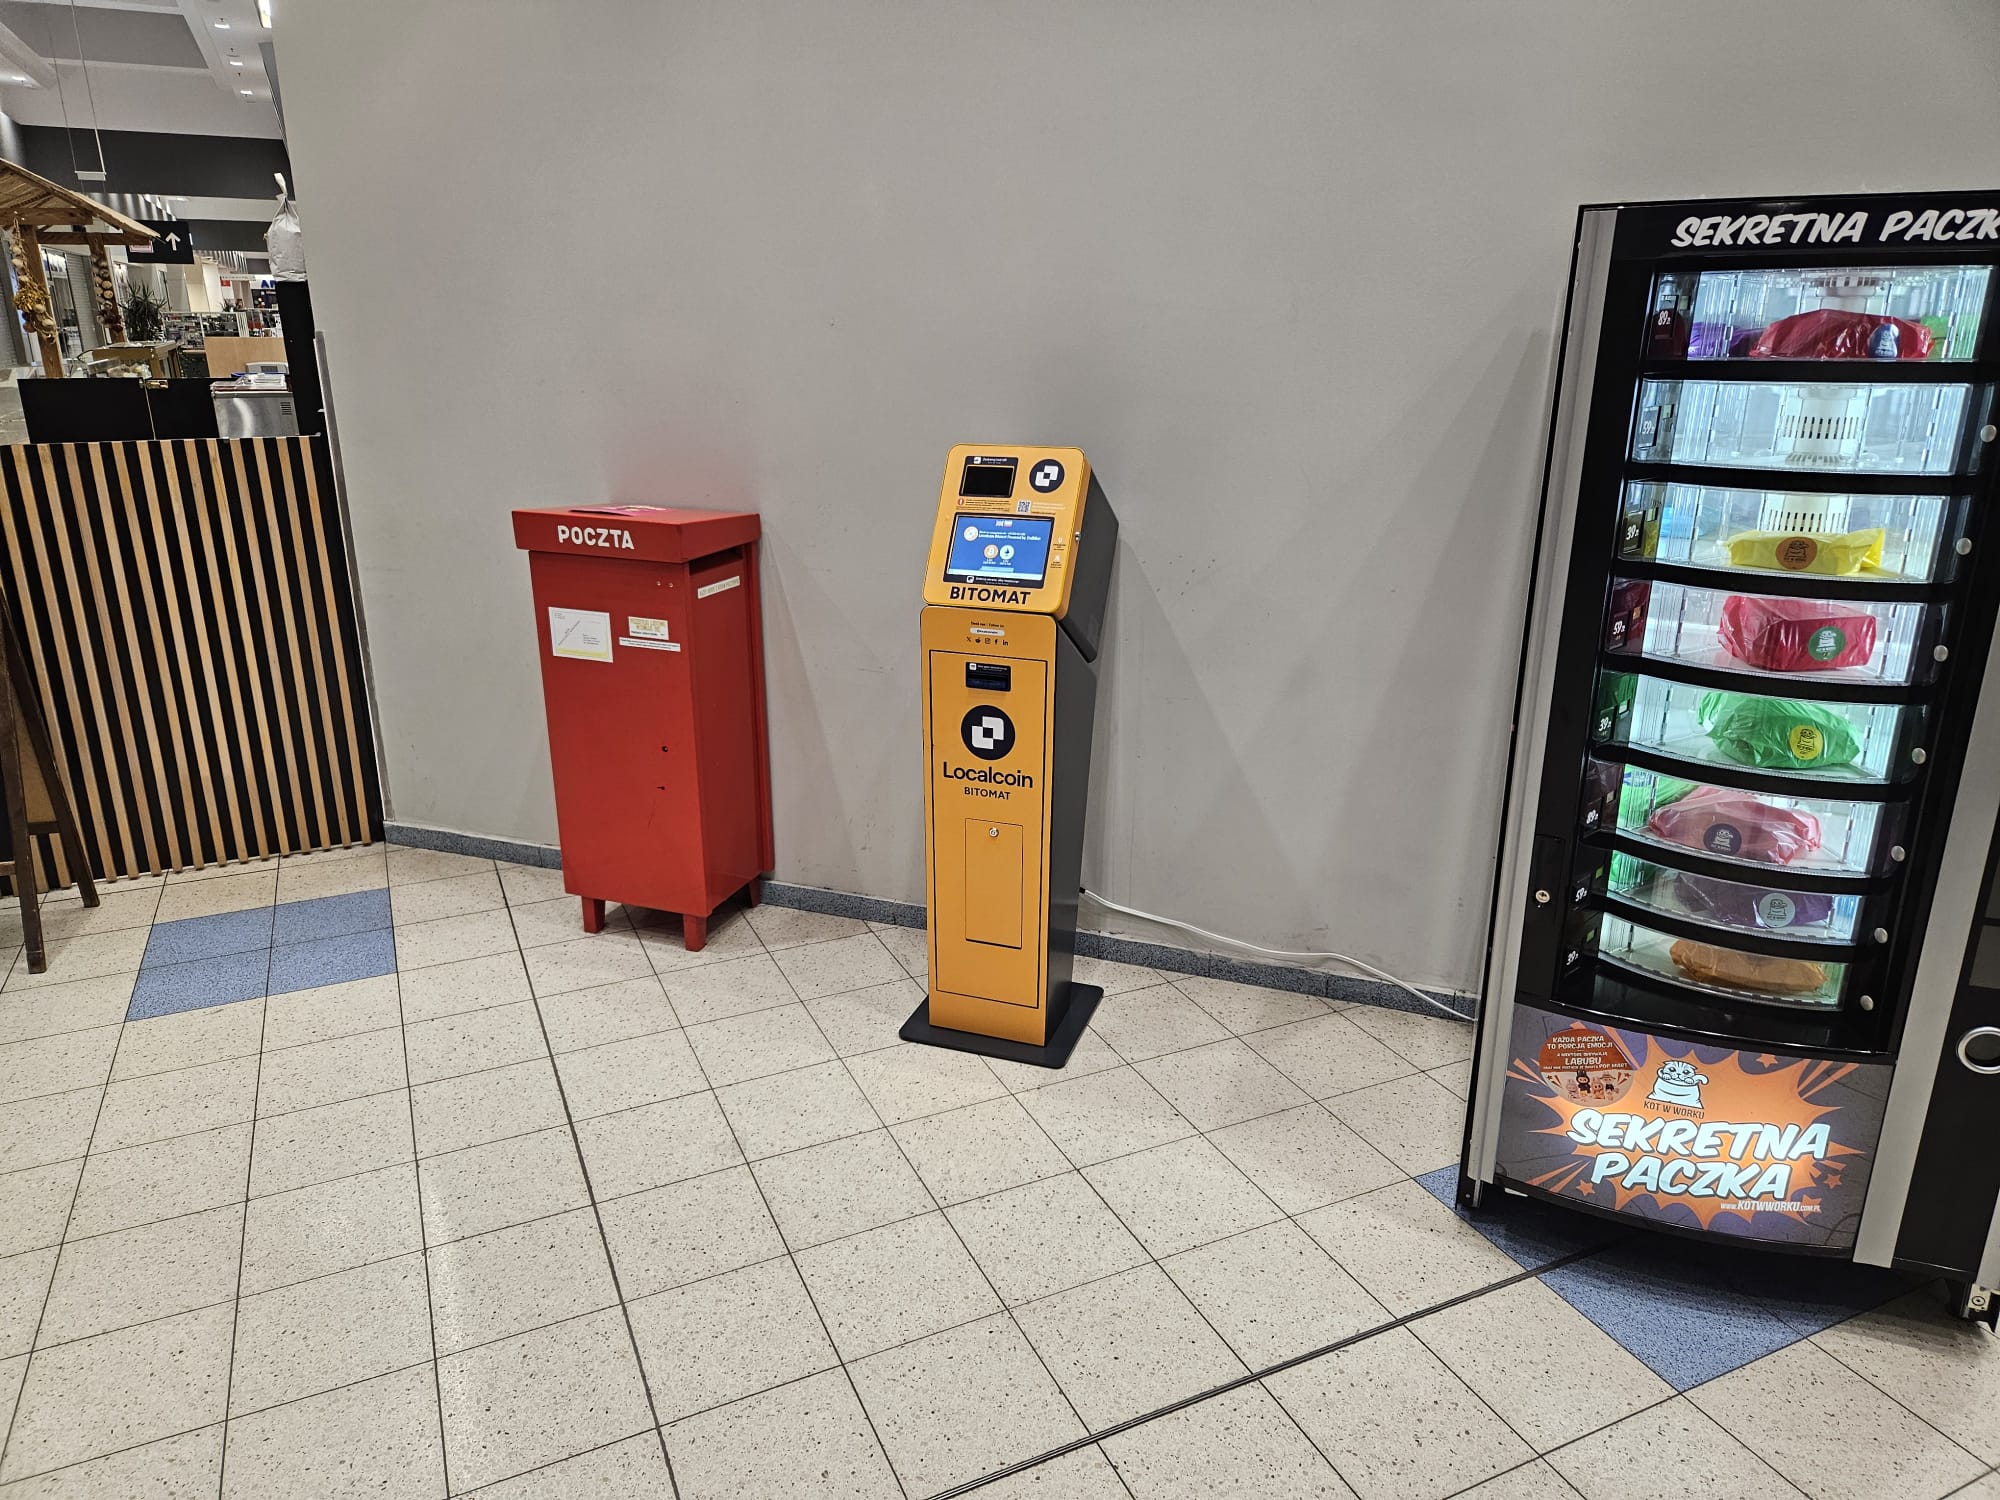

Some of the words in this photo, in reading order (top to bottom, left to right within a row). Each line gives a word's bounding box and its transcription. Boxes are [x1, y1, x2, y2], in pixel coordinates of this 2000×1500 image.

[1670, 211, 1869, 247] SEKRETNA
[557, 524, 635, 550] POCZTA
[949, 586, 1031, 605] BITOMAT
[943, 761, 1033, 788] Localcoin
[964, 786, 1011, 800] BITOMAT
[1565, 1057, 1602, 1065] LABUBU
[1643, 1101, 1660, 1111] KOT
[1663, 1104, 1671, 1113] W
[1672, 1106, 1705, 1120] WORKU
[1566, 1107, 1831, 1161] SEKRETNA
[1590, 1152, 1793, 1200] PACZKA
